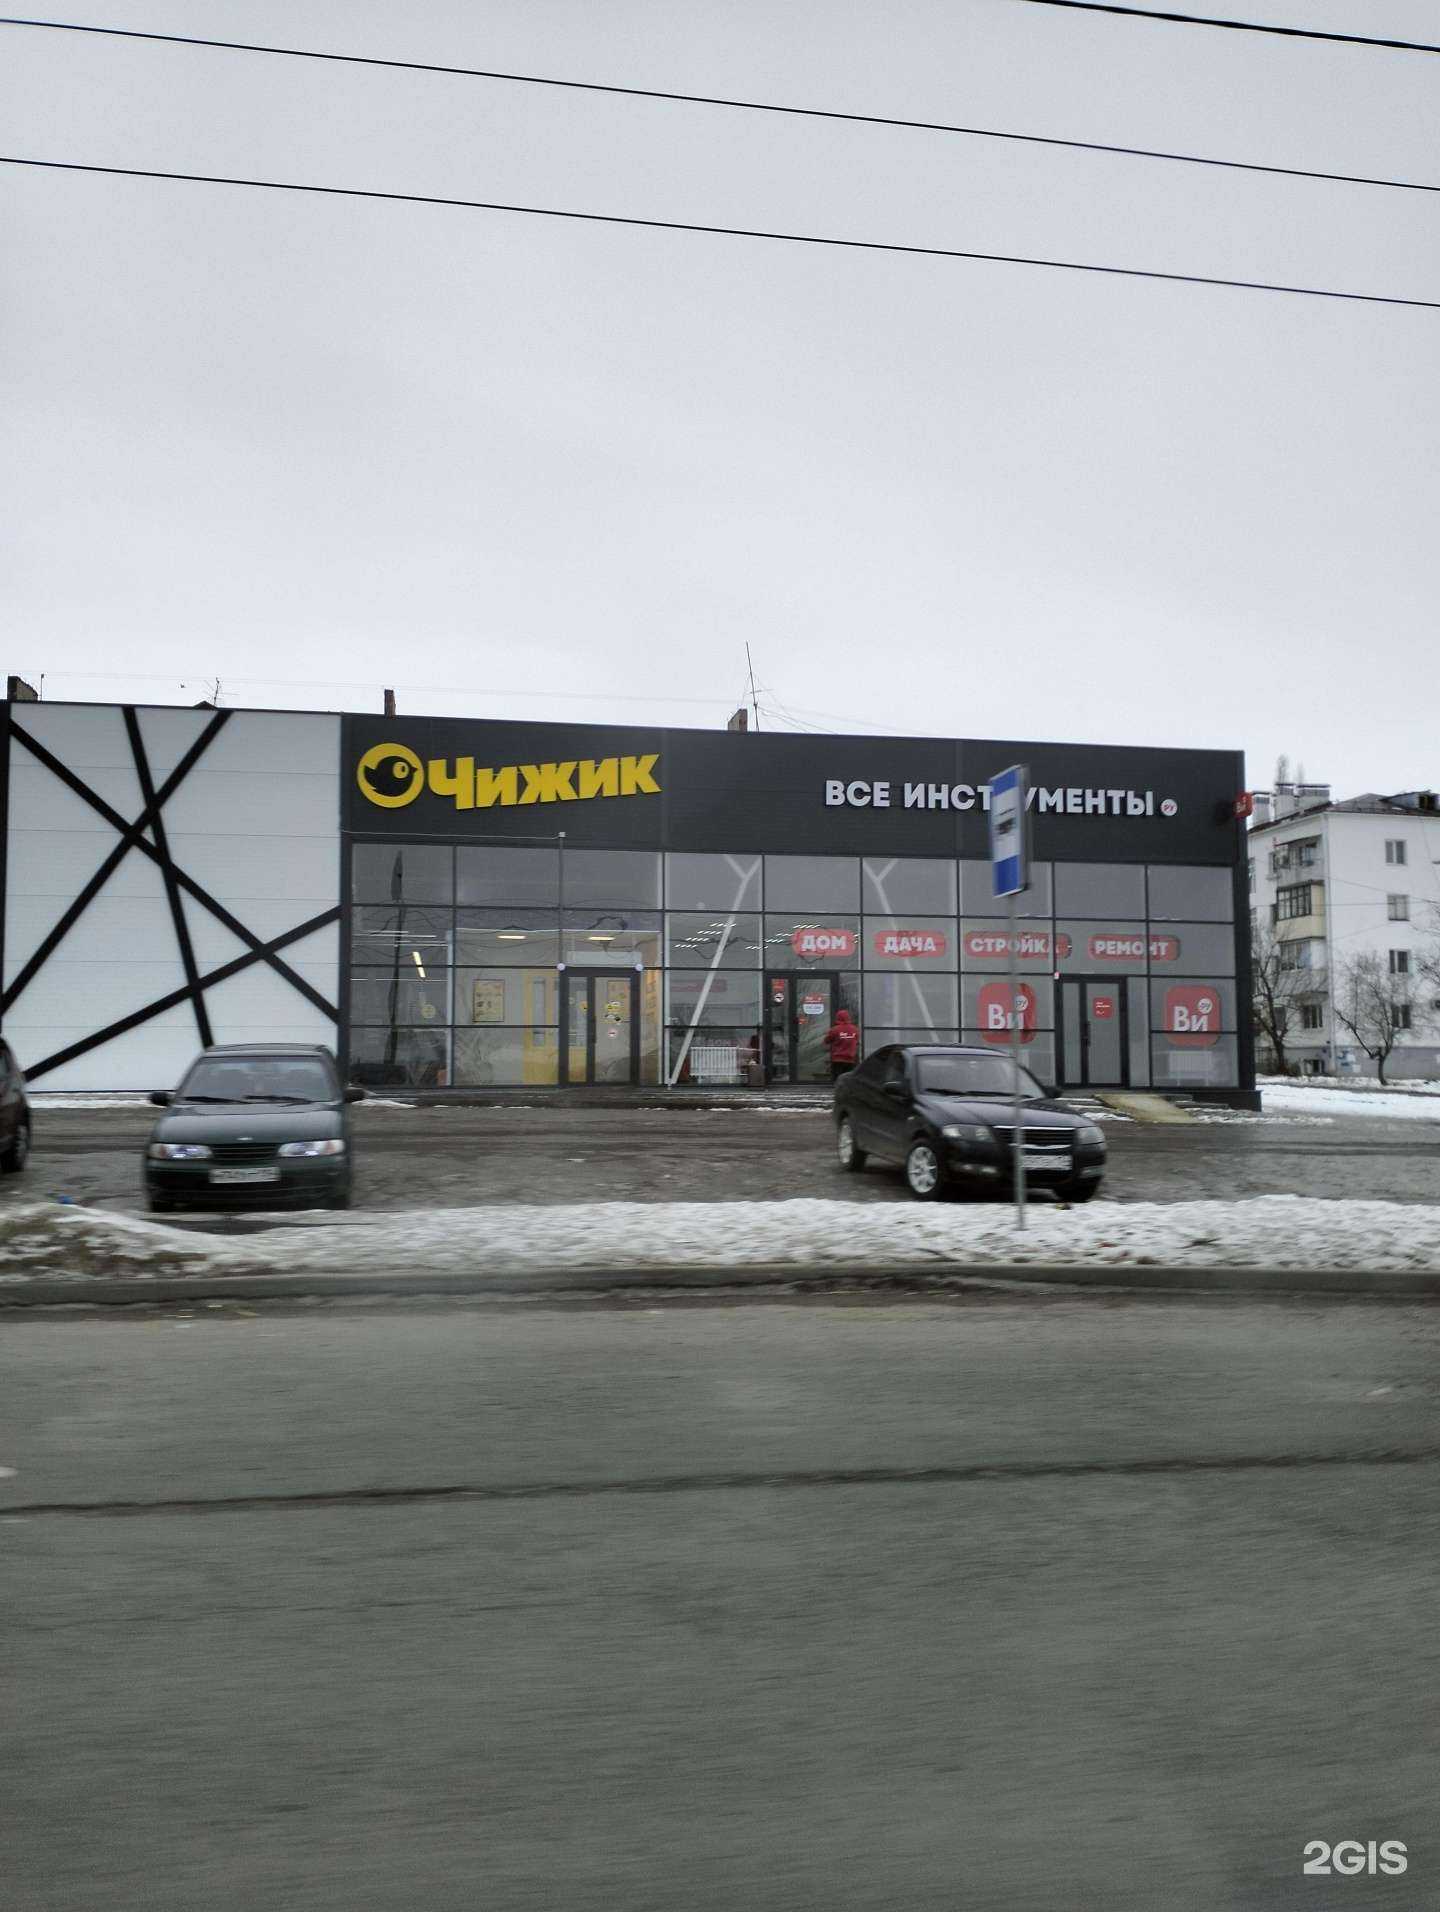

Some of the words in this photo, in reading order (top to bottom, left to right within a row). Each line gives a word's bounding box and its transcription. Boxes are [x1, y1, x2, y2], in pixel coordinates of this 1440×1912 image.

[825, 779, 891, 807] ВСЕ
[903, 782, 1154, 817] ИНСТУМЕНТЫ
[801, 935, 847, 952] ДОМ
[883, 936, 937, 953] ДАЧА
[1095, 940, 1169, 956] РЕМОНТ
[1173, 1006, 1209, 1032] Ви
